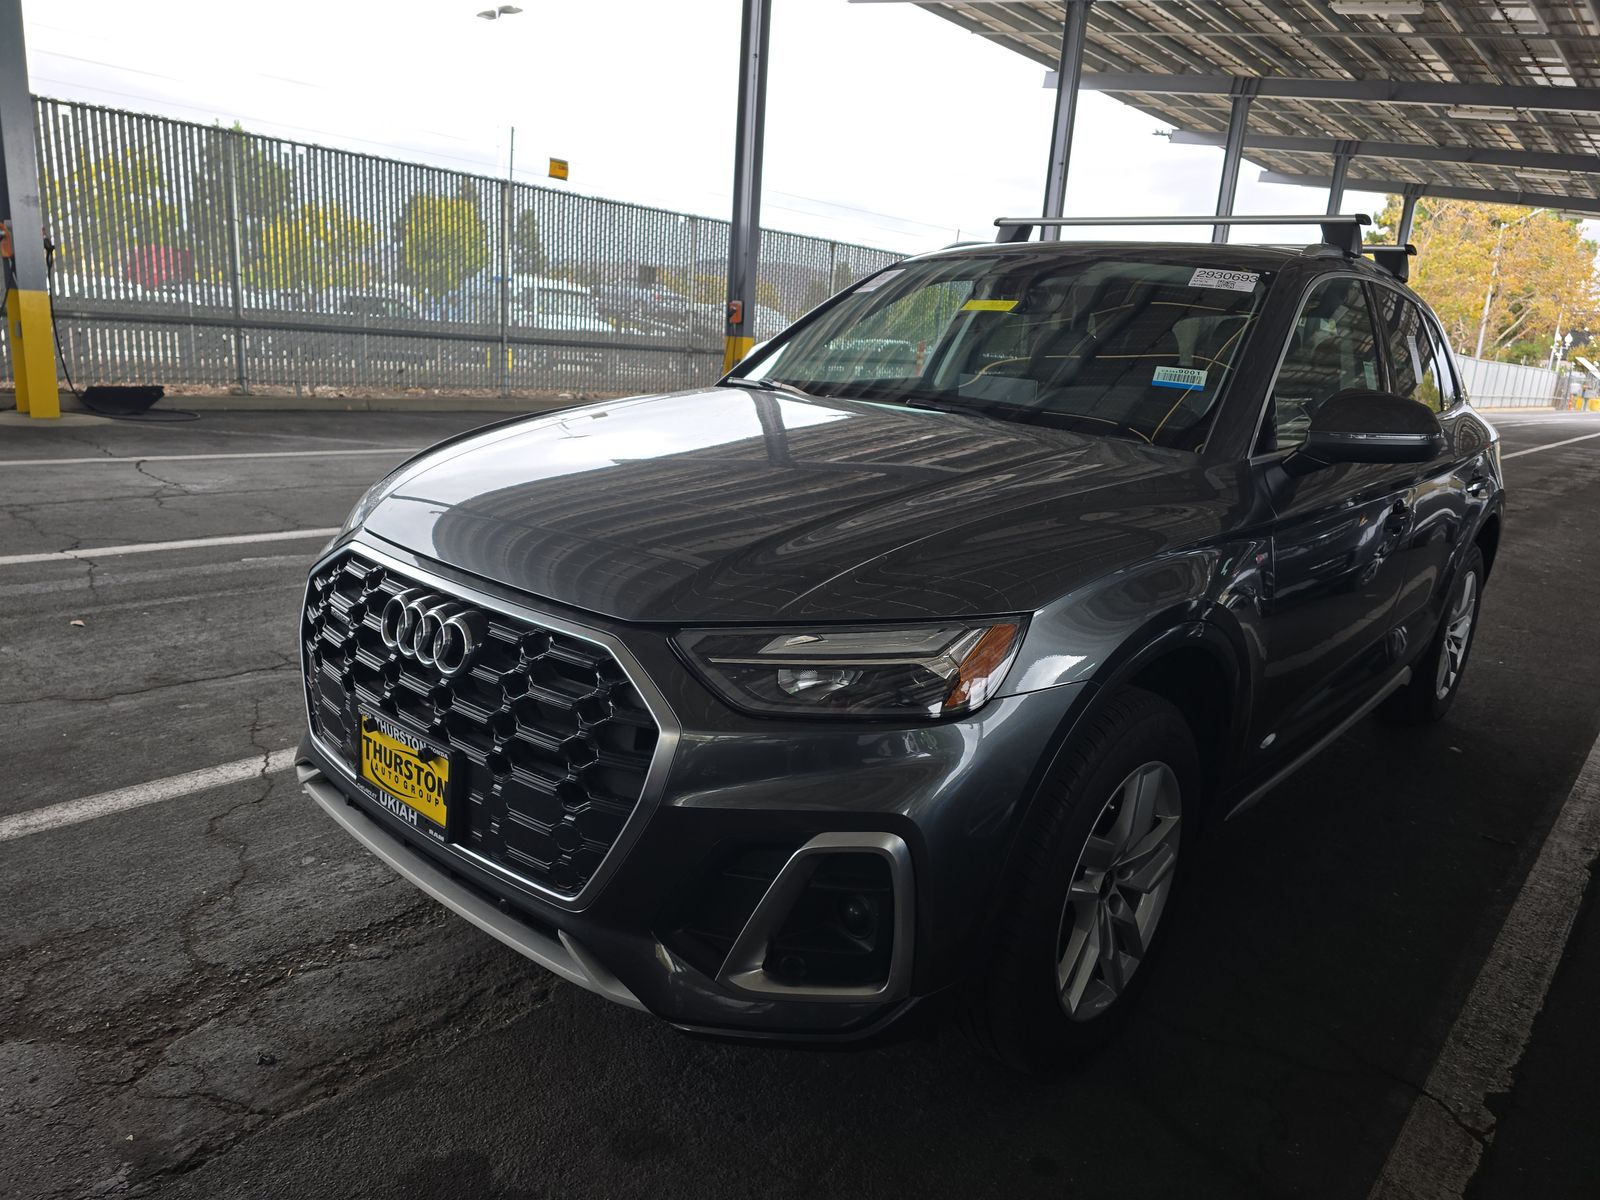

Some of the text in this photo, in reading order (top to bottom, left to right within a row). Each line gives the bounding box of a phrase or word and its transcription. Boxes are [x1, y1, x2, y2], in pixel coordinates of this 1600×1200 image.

[1196, 270, 1259, 283] 2930693
[374, 716, 427, 751] THURSTON
[362, 734, 448, 806] THURSTON
[379, 789, 418, 826] UKIAH
